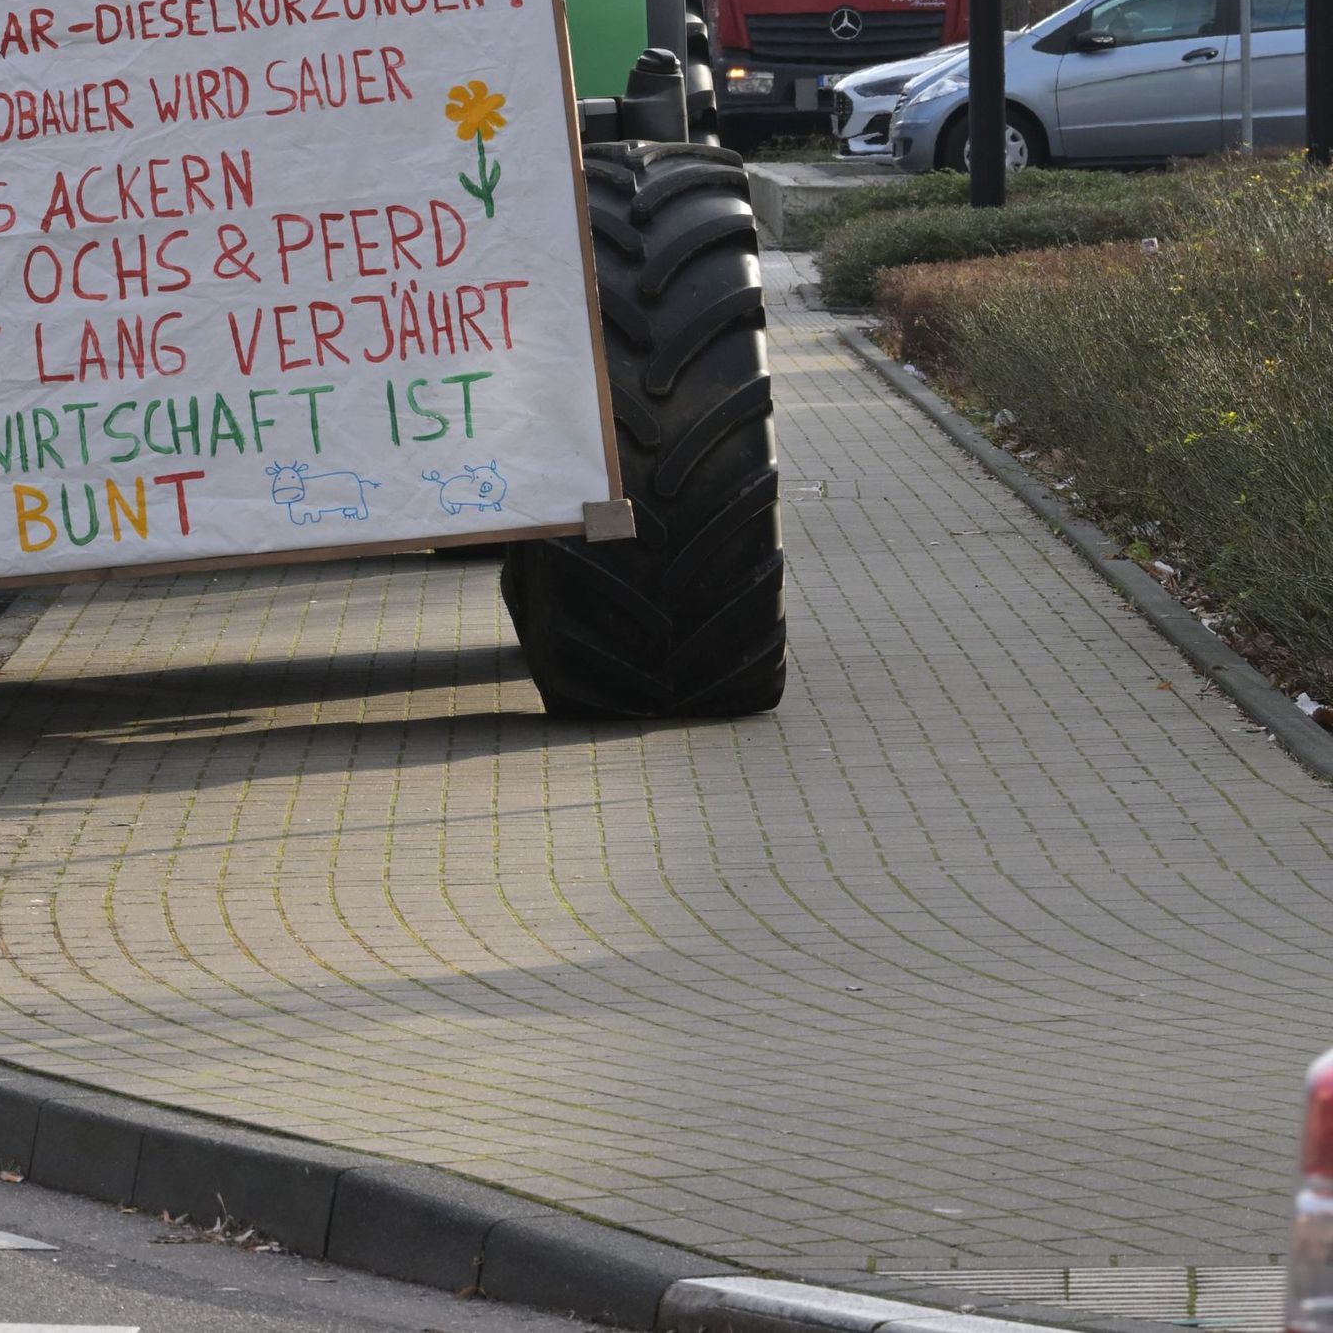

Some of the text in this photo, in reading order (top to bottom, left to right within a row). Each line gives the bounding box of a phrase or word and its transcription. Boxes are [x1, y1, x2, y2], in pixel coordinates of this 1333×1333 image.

[149, 66, 250, 123] WIRD
[265, 46, 413, 116] SAUER
[40, 149, 254, 233] ACKERN
[23, 229, 191, 304] OCHS
[213, 224, 261, 283] &
[272, 199, 467, 284] PFERD
[35, 312, 187, 384] LANG
[228, 279, 530, 375] VERJÄHRT
[386, 371, 493, 447] IST
[13, 470, 205, 552] BUNT
